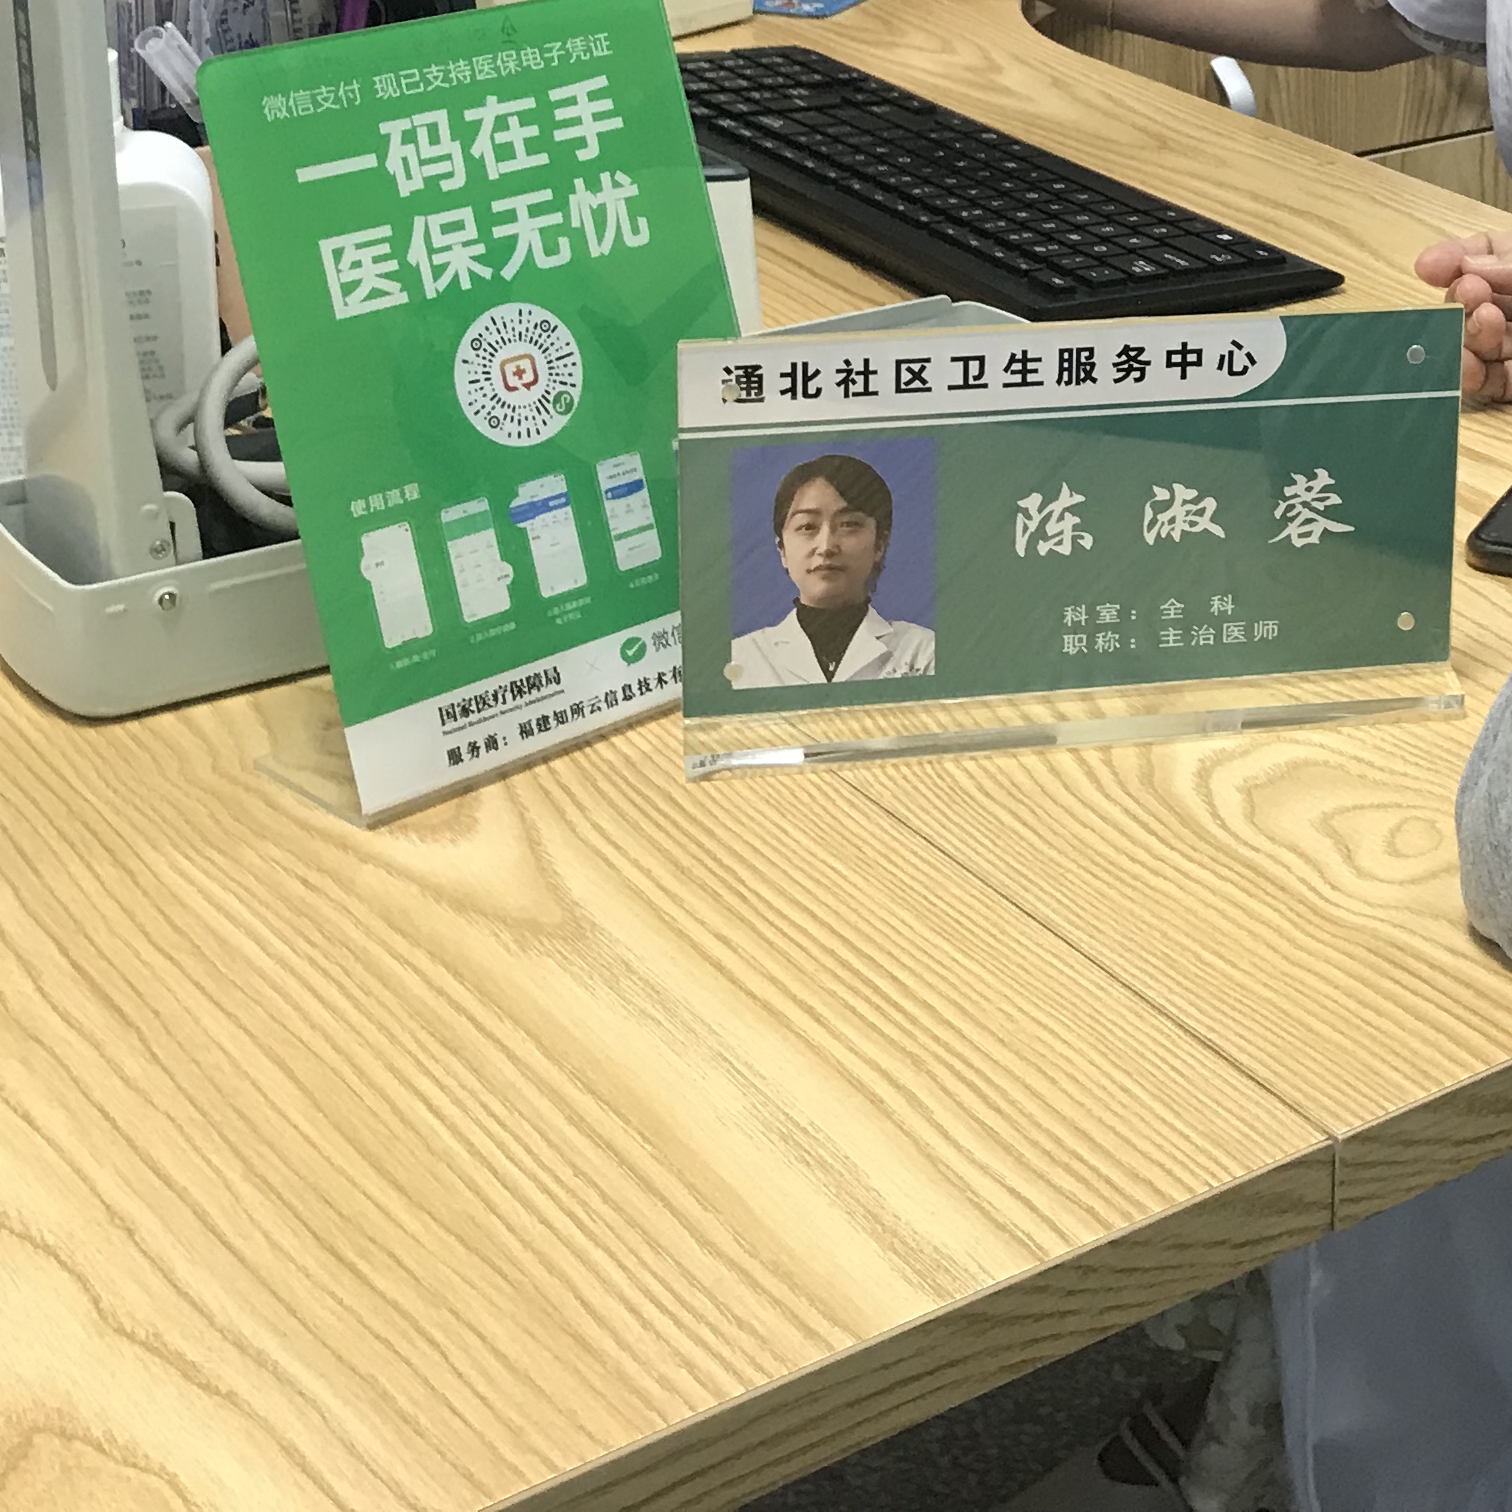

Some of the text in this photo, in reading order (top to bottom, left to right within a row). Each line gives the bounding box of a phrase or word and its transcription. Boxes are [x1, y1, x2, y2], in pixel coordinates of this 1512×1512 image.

[262, 33, 613, 122] 微信支付 现已支持医保电子凭证
[296, 75, 624, 198] 一码在手
[318, 170, 650, 320] 医保无忧
[721, 338, 1259, 405] 通北社区卫生服务中心
[350, 483, 421, 519] 使用流程
[1014, 467, 1356, 558] 陈淑蓉
[438, 666, 562, 727] 国家医疗保障局
